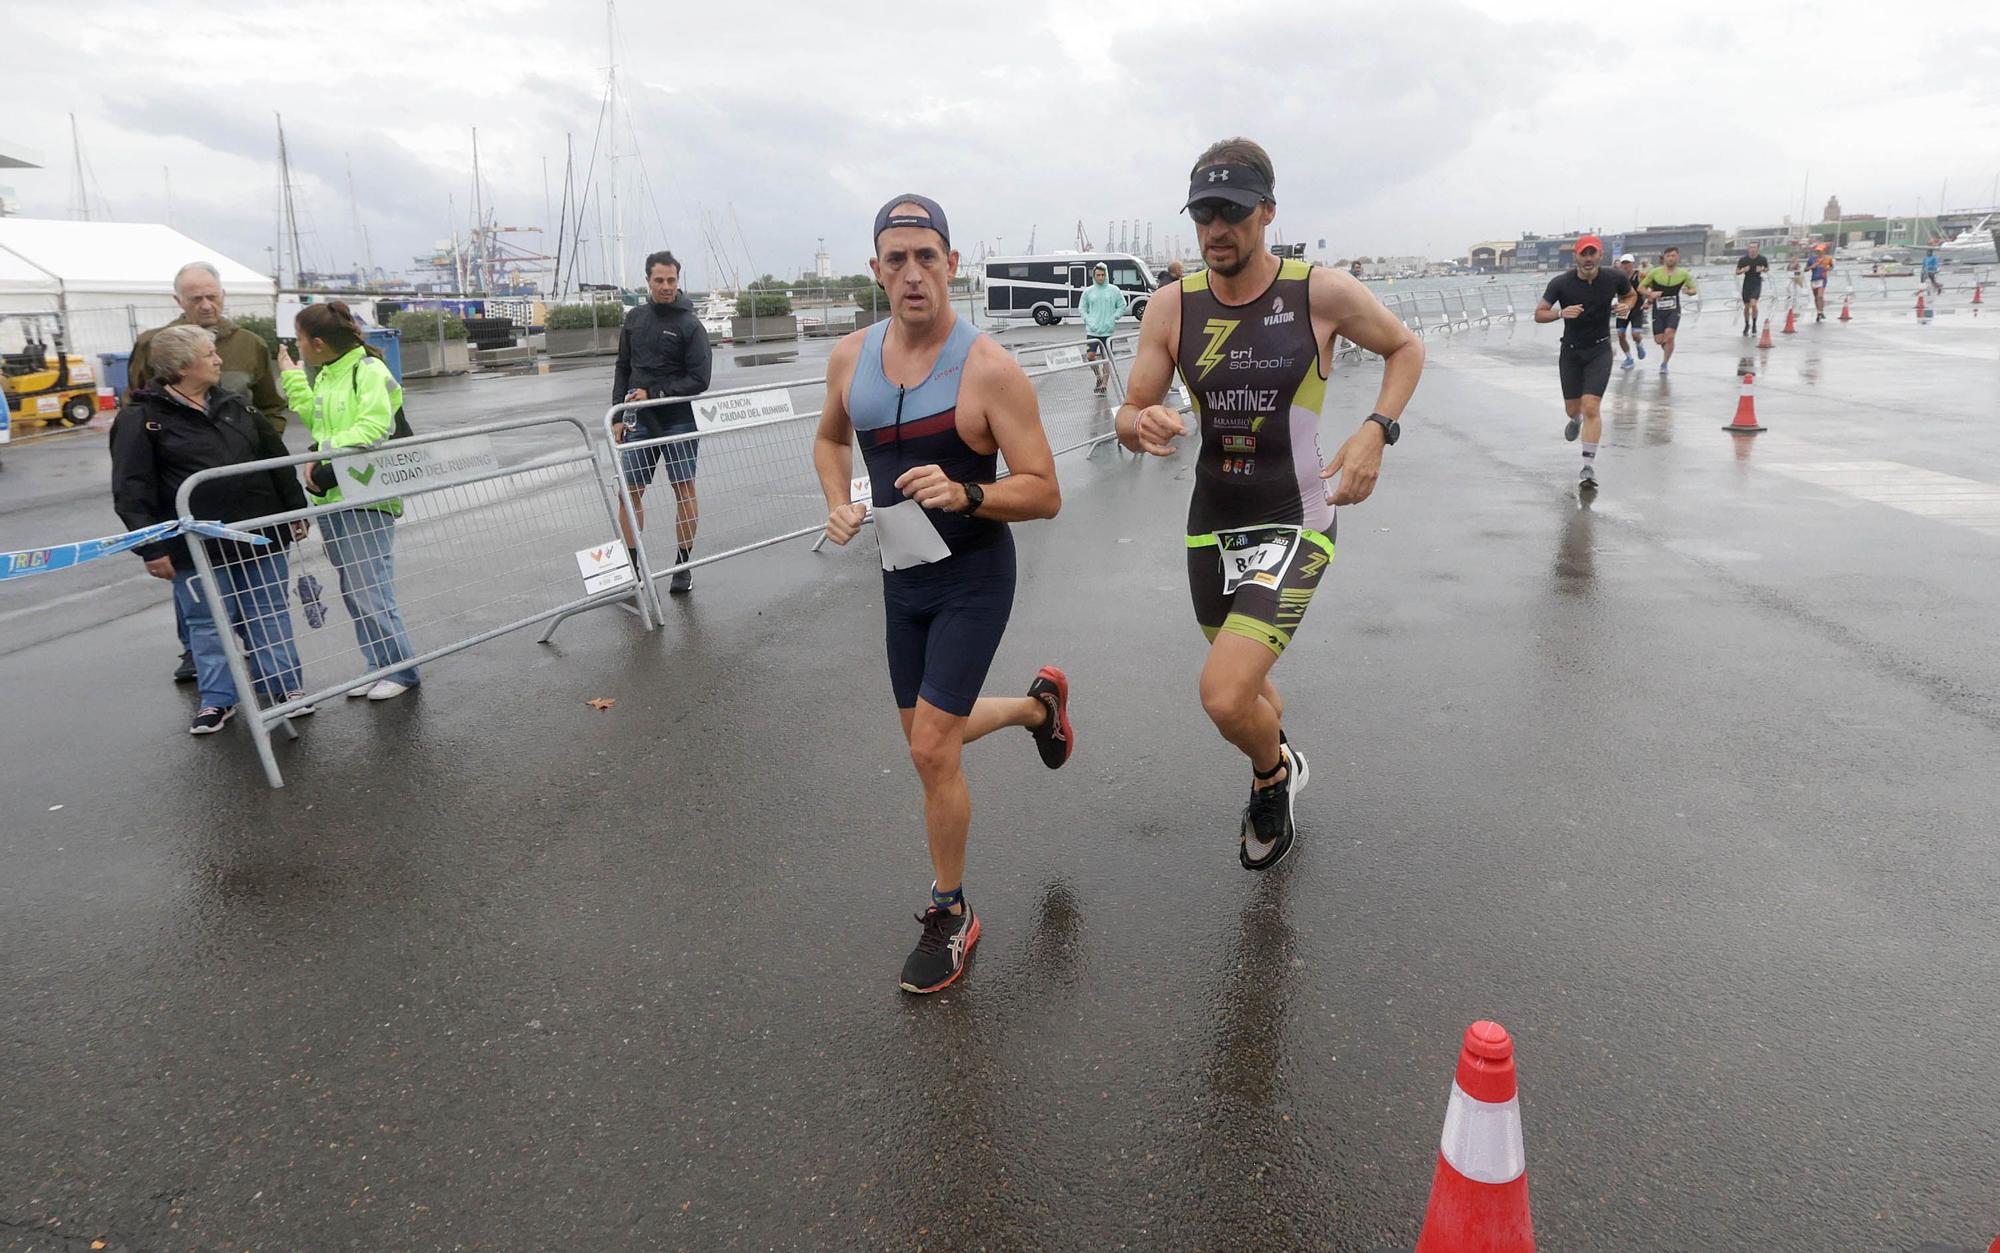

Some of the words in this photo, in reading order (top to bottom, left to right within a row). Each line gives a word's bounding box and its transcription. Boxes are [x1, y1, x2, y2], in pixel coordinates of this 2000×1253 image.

[1264, 312, 1295, 326] VIATOR
[1230, 347, 1253, 359] tri
[1229, 356, 1283, 370] school
[717, 398, 751, 410] VALENCIA
[1206, 384, 1278, 411] MARTÍNEZ
[720, 411, 747, 423] CIUDAD
[747, 407, 760, 418] DEL
[762, 403, 789, 416] RUNNING
[376, 449, 432, 468] VALENCIA
[380, 466, 424, 486] CIUDAD
[425, 462, 446, 477] DEL
[449, 454, 492, 472] RUNNING
